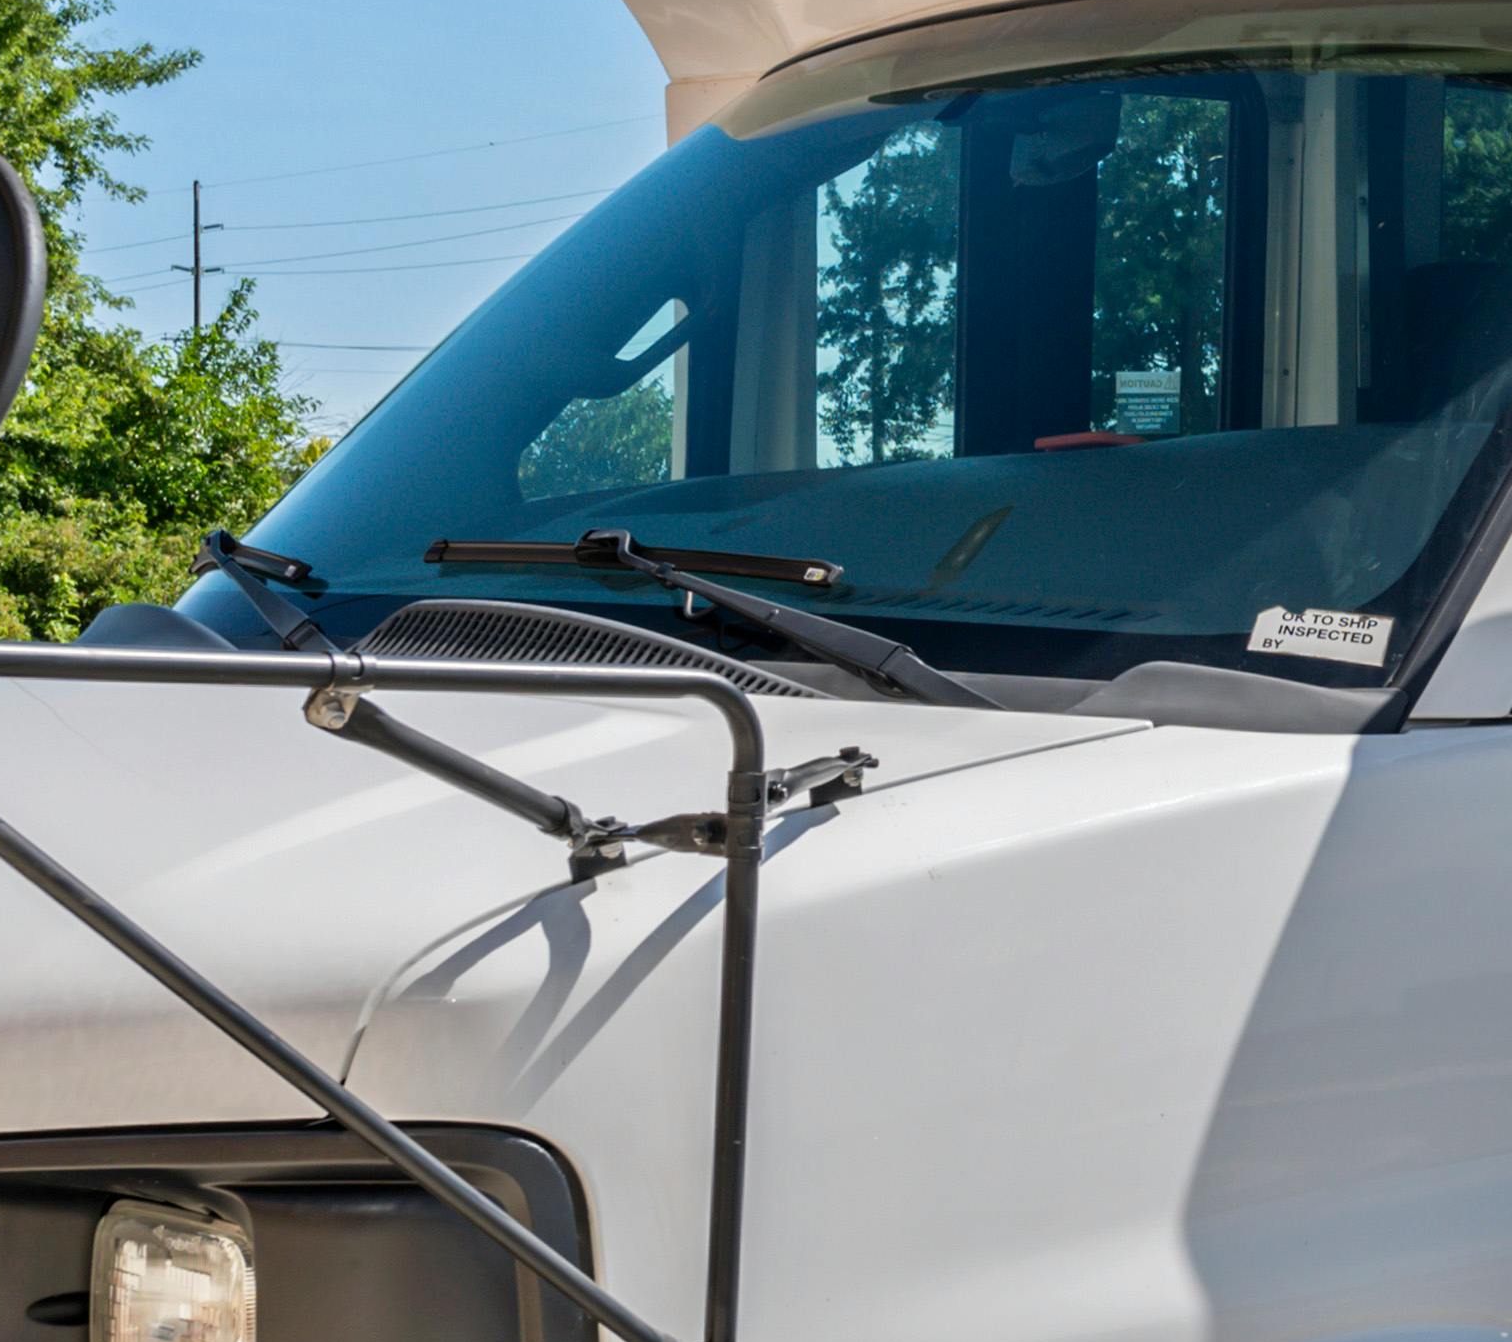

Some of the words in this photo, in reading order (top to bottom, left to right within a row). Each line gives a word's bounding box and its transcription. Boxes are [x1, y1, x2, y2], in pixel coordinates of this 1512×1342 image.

[1282, 612, 1306, 624] OK
[1312, 614, 1334, 626] TO
[1338, 616, 1379, 630] SHIP
[1278, 624, 1374, 645] INSPECTED
[1262, 638, 1284, 650] BY
